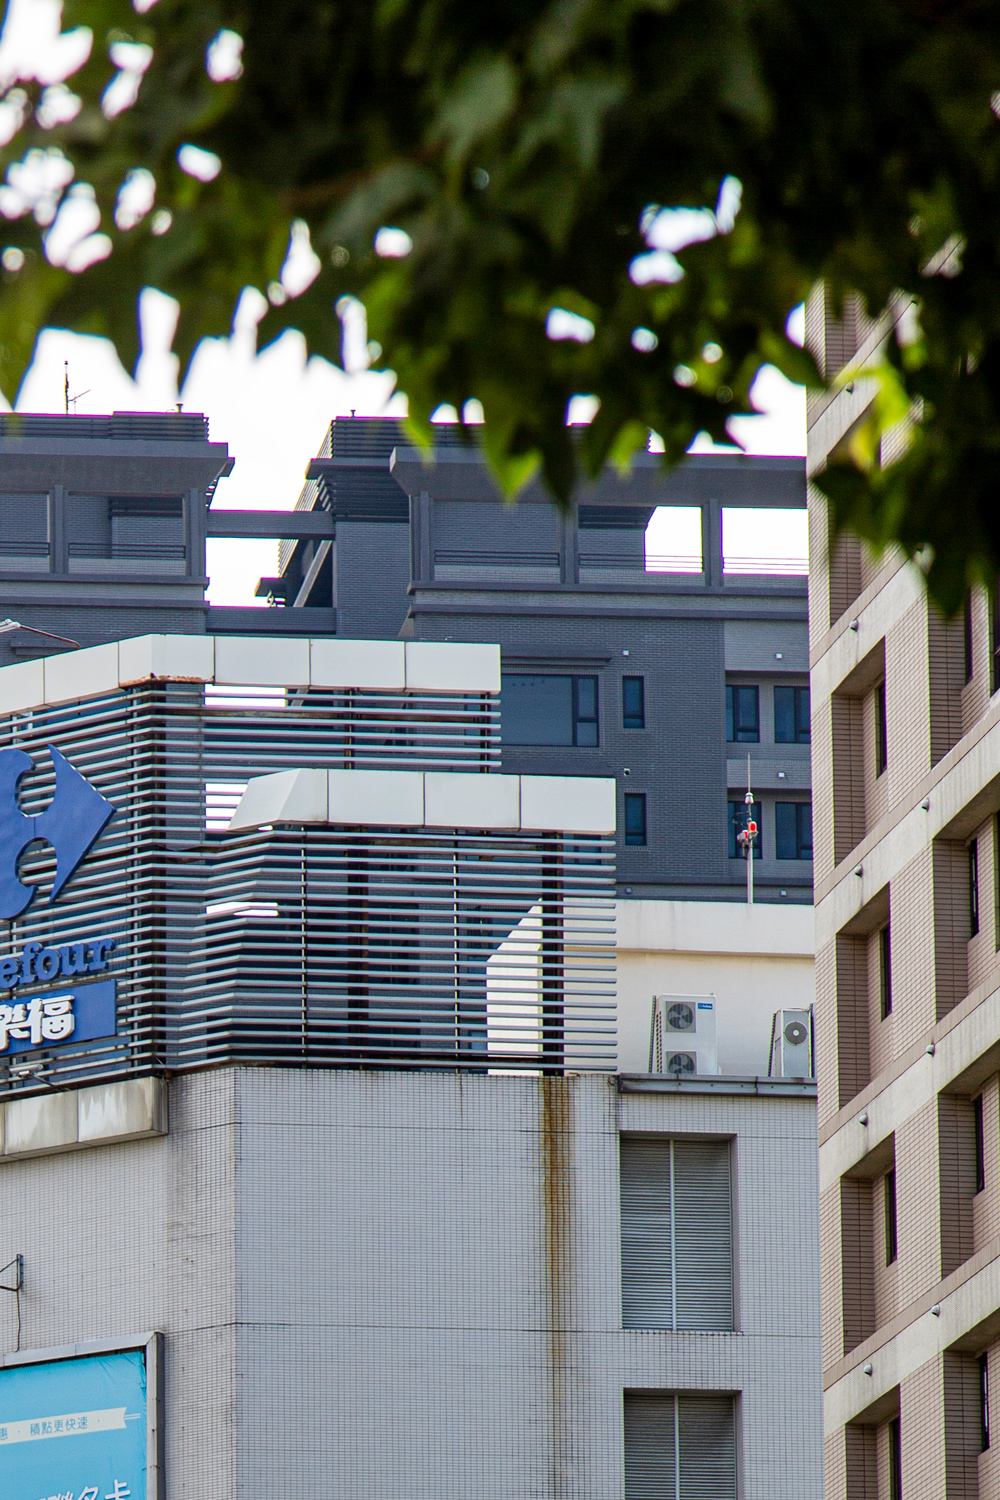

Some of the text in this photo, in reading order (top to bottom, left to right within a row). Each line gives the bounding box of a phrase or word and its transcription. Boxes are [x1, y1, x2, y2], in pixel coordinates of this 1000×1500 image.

[29, 1416, 88, 1436] 積點更快速
